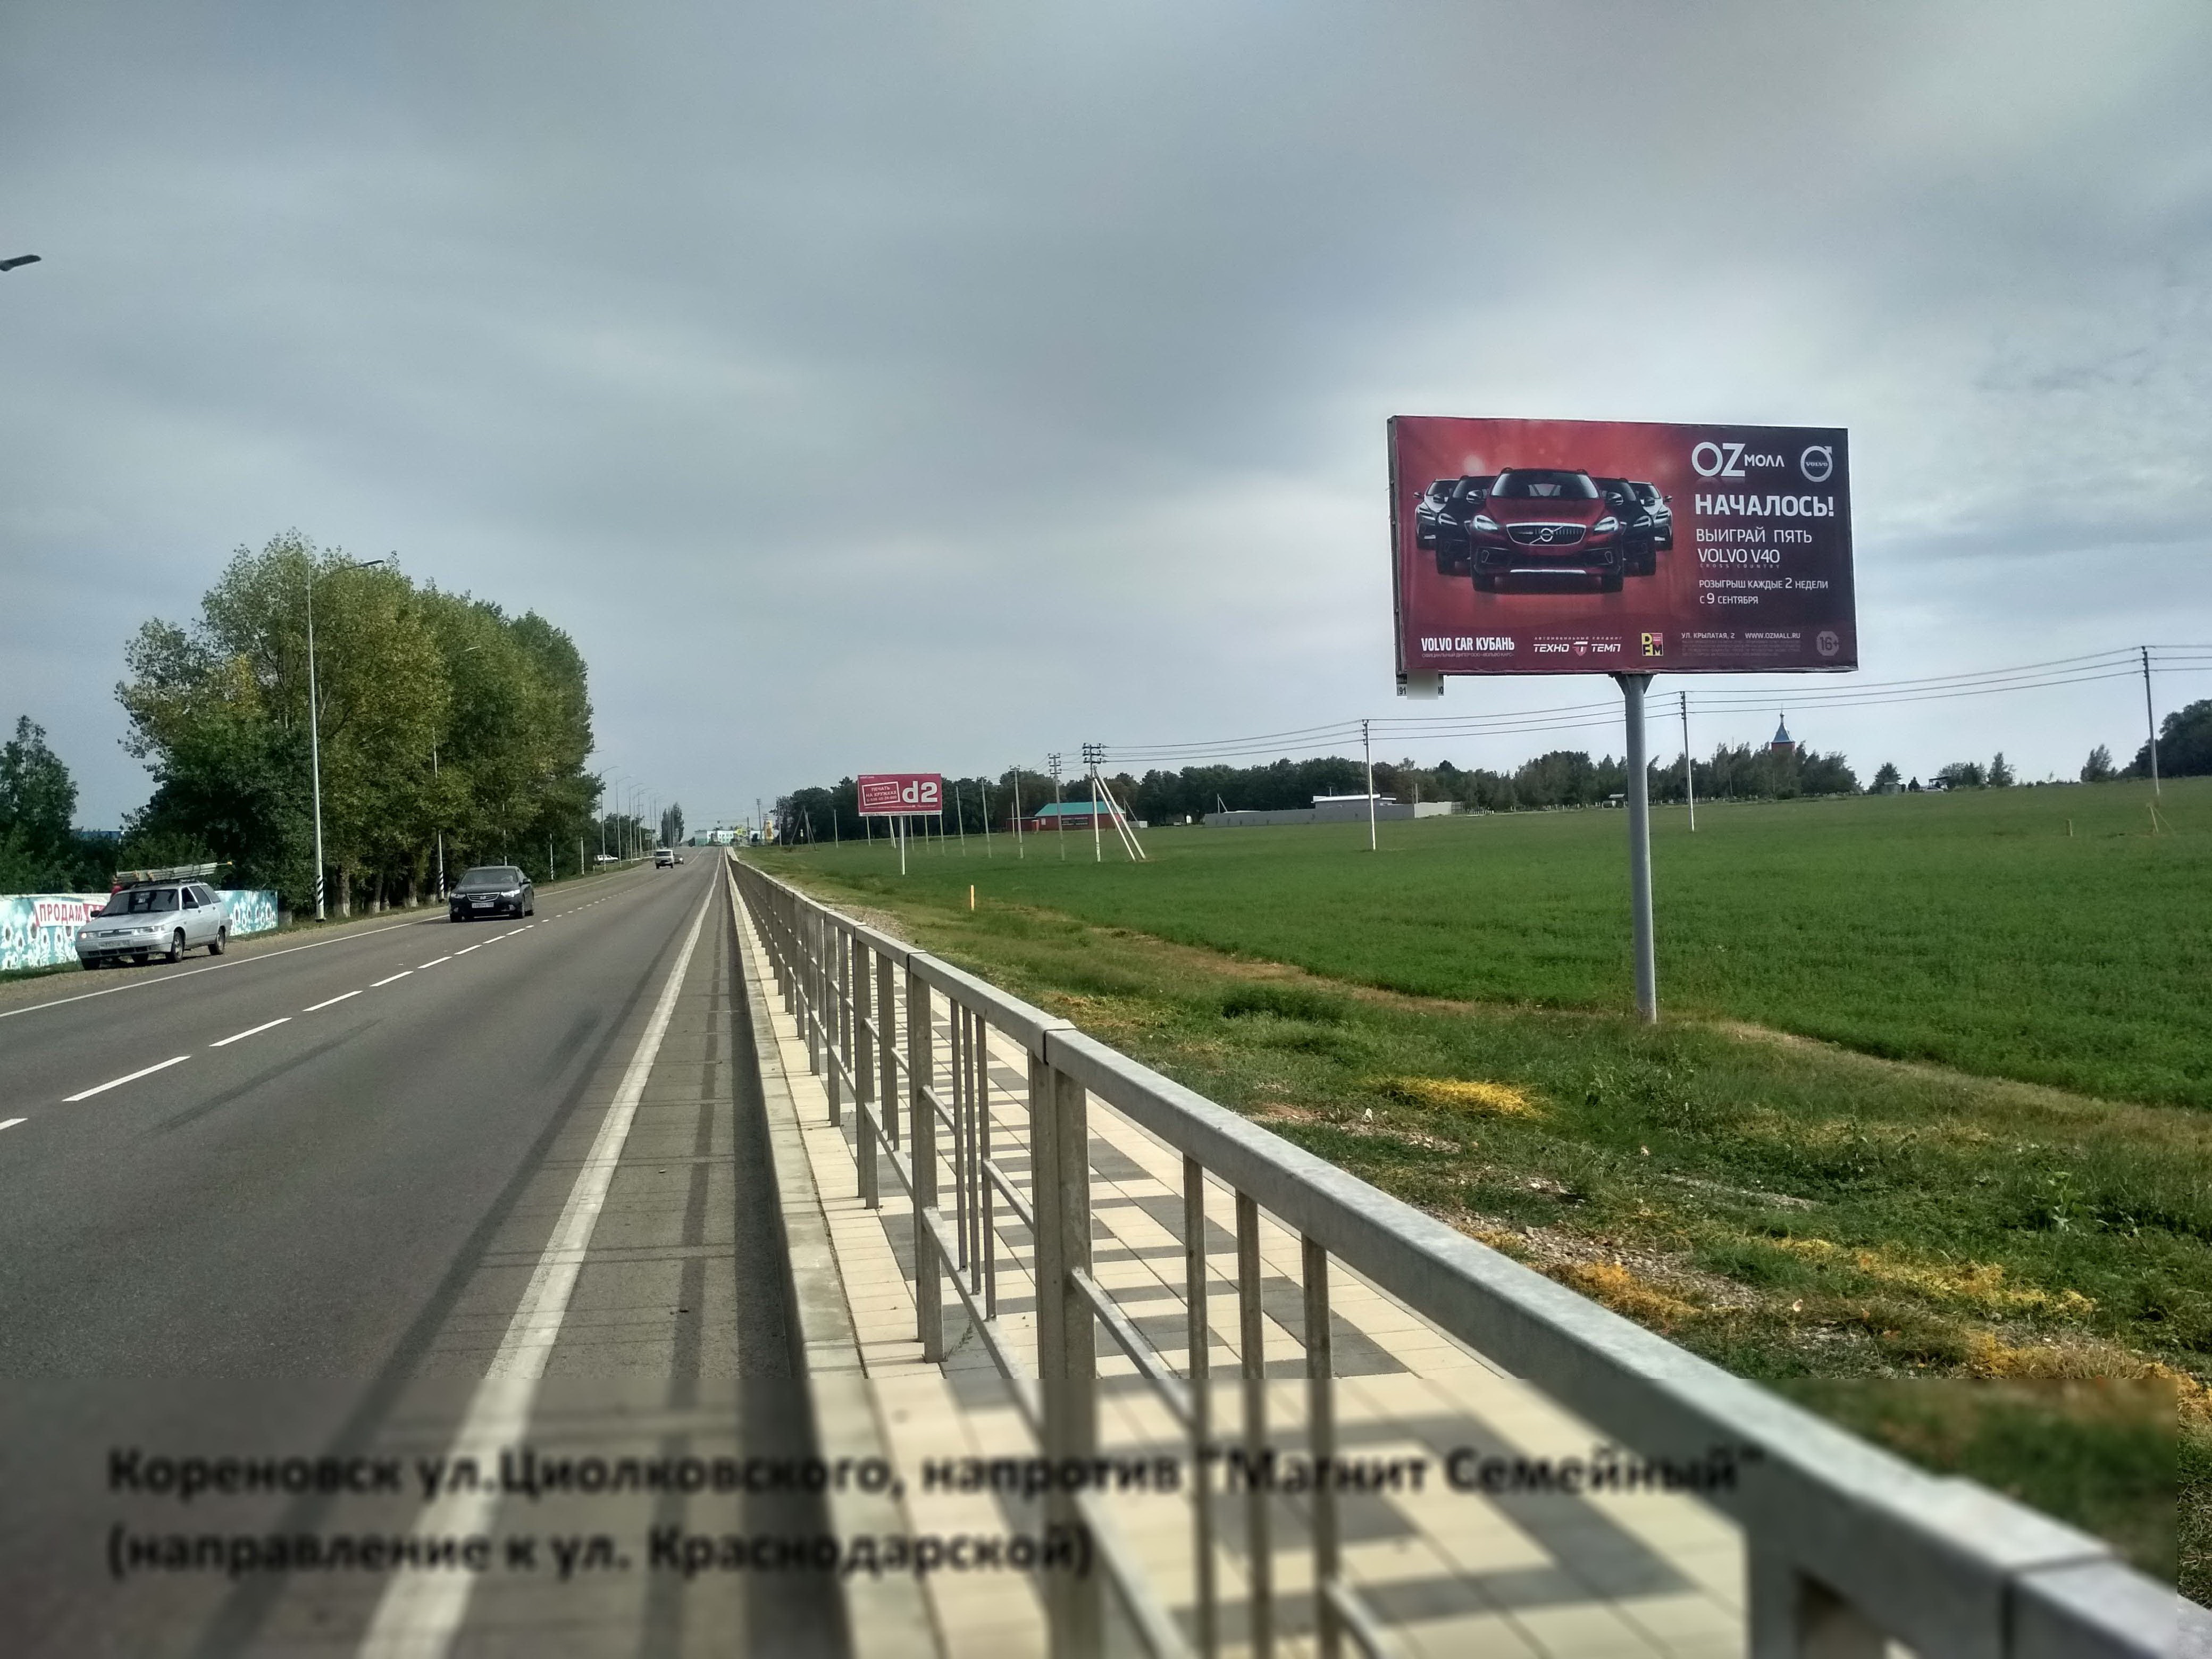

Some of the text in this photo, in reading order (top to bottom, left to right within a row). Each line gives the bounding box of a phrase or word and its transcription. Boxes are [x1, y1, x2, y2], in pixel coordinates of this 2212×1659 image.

[1691, 441, 1746, 477] OZ
[1695, 493, 1834, 517] НАЧАЛОСЬ!
[1696, 526, 1813, 543] ВЫИГРАЙ ПЯТЬ
[1698, 548, 1781, 564] VOLVO V40
[1699, 577, 1829, 591] РОЗЫГРЫШ КАЖДЫЕ 2 НЕДЕЛИ
[1706, 592, 1715, 604] 9
[1717, 596, 1758, 604] СЕНТЯБРЯ
[1421, 637, 1515, 651] VOLVO CAR КУБАНЬ
[1533, 644, 1569, 652] ТЕХНО
[1591, 644, 1621, 652] ТЕМП
[1820, 636, 1839, 651] 16+
[902, 781, 938, 803] d2
[39, 904, 82, 925] ПРОДАМ
